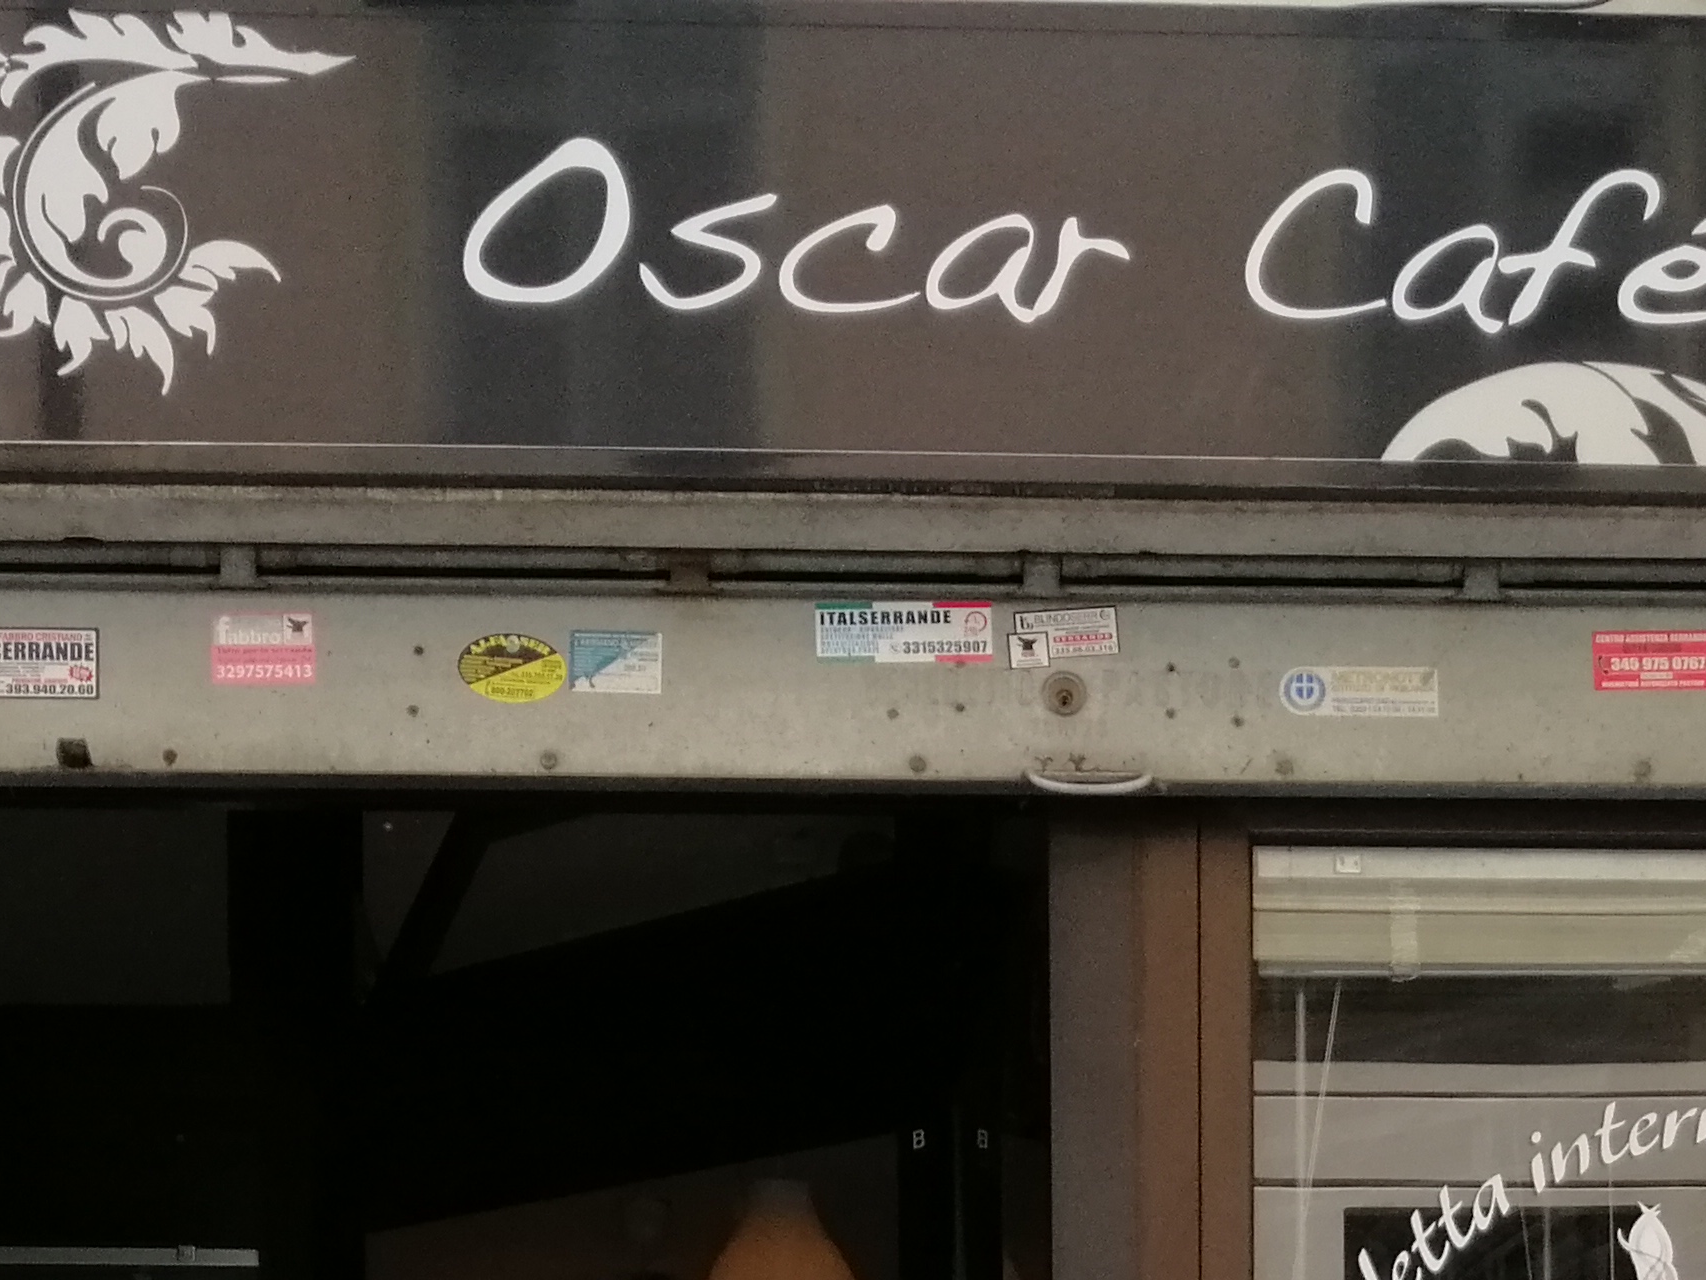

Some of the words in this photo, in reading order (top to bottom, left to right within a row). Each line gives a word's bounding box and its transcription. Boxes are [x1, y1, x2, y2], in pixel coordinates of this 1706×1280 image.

[461, 136, 1132, 325] Oscar
[820, 610, 952, 626] ITALSERRANDE
[35, 632, 83, 642] CRISTIANO
[216, 664, 313, 679] 3297575413
